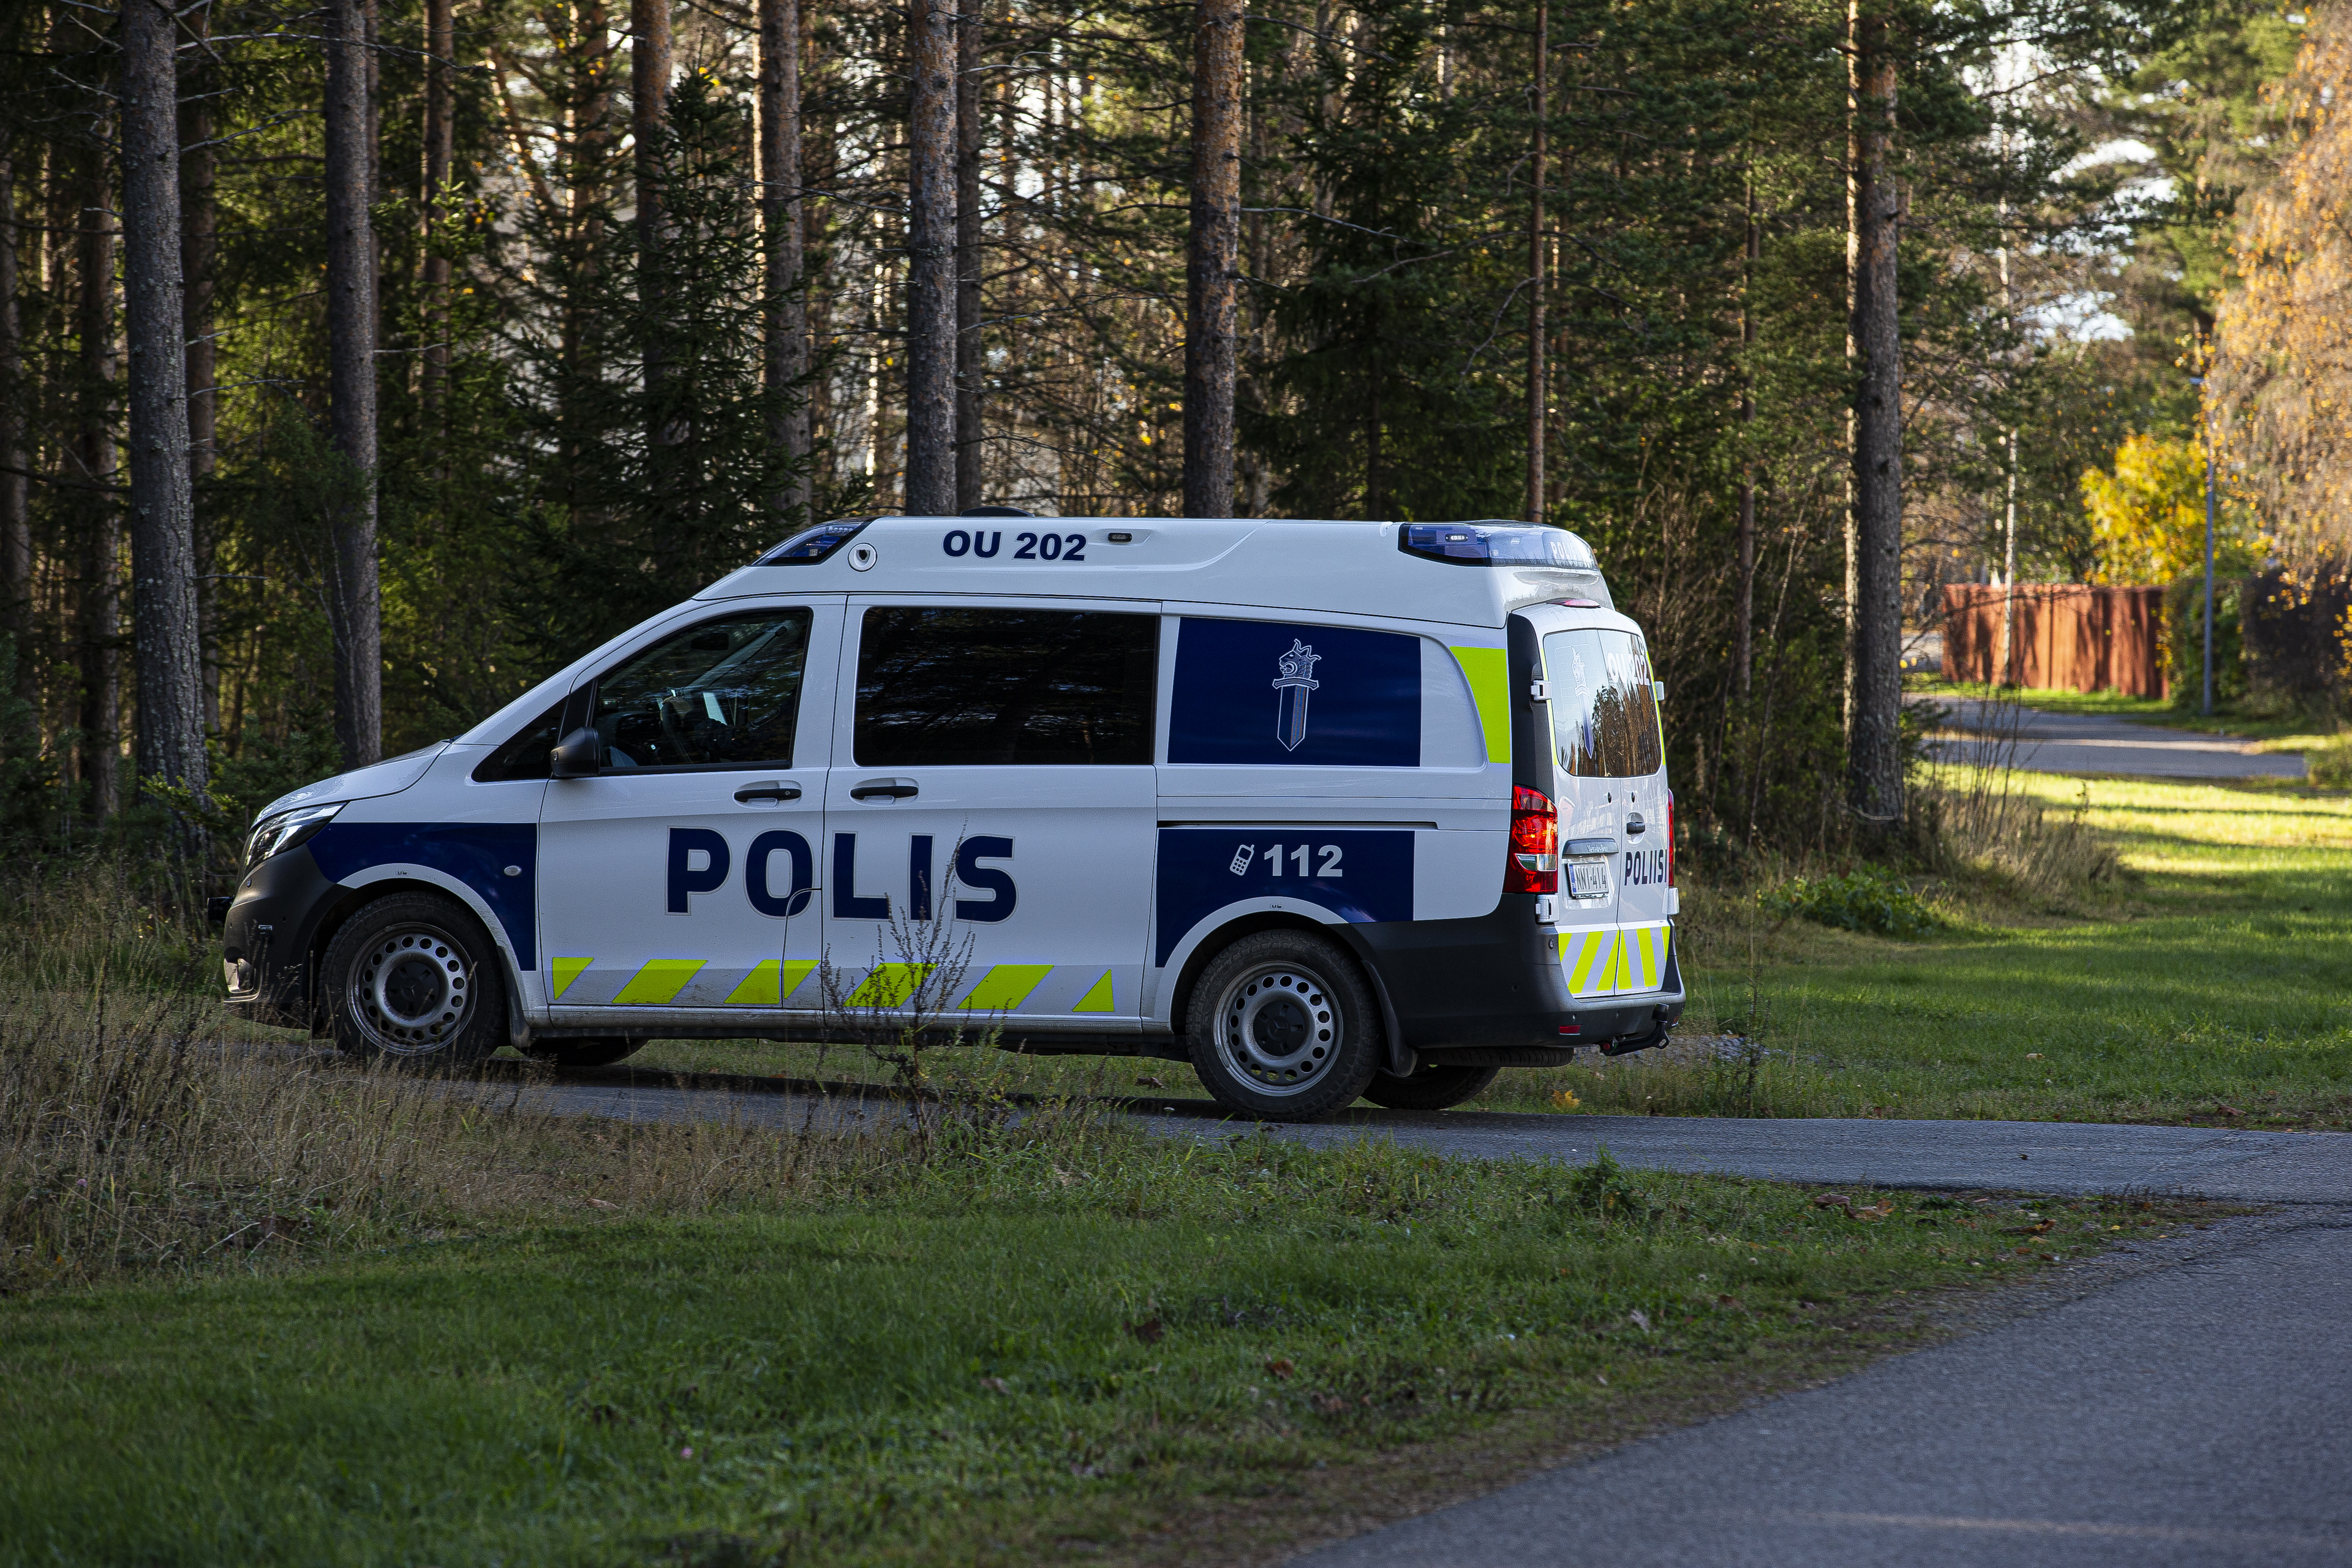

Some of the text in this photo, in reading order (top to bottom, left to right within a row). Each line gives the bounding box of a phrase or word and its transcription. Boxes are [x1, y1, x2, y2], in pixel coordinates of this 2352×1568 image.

[943, 530, 1087, 561] OU 202
[1607, 652, 1650, 685] OU 202
[666, 827, 1017, 922] POLIS
[1264, 844, 1343, 876] 112
[1624, 849, 1667, 886] POLIISI
[1574, 865, 1607, 891] NNI-414
